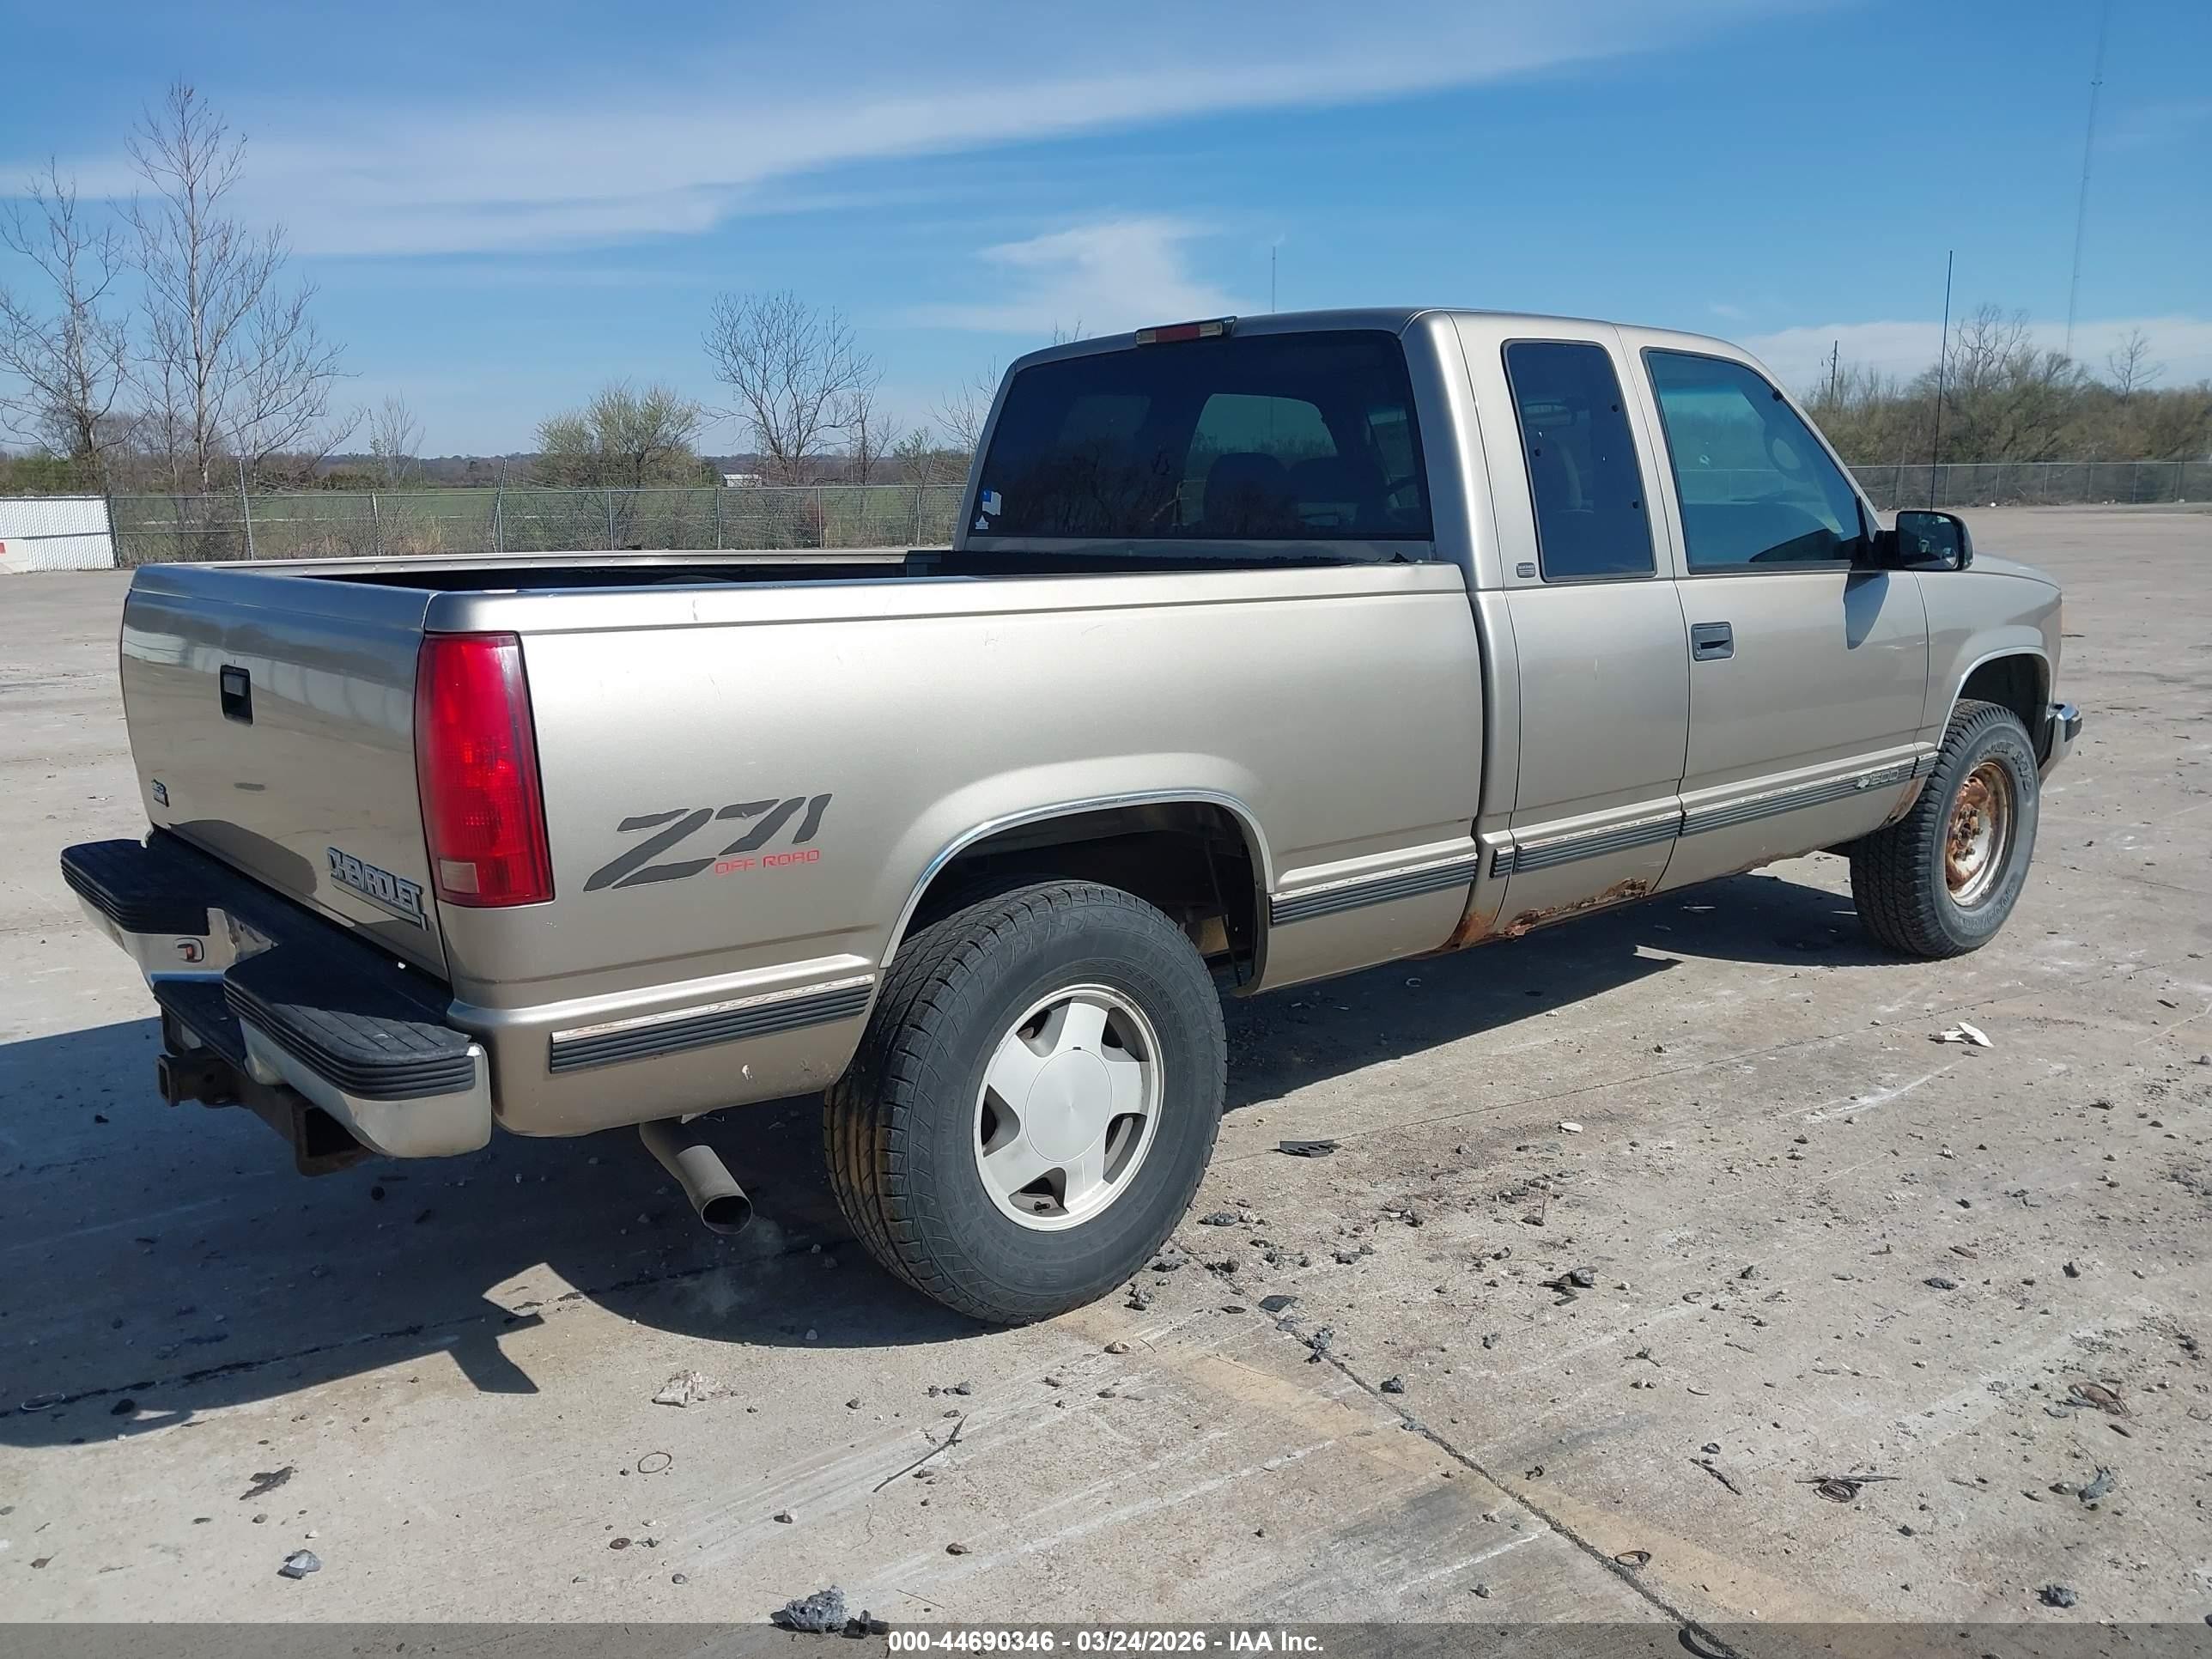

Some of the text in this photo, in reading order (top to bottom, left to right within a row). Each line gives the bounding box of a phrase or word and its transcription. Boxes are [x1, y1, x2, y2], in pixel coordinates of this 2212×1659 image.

[583, 793, 833, 892] Z71
[715, 850, 820, 874] OFF ROAD
[327, 847, 425, 915] CHEVROLET
